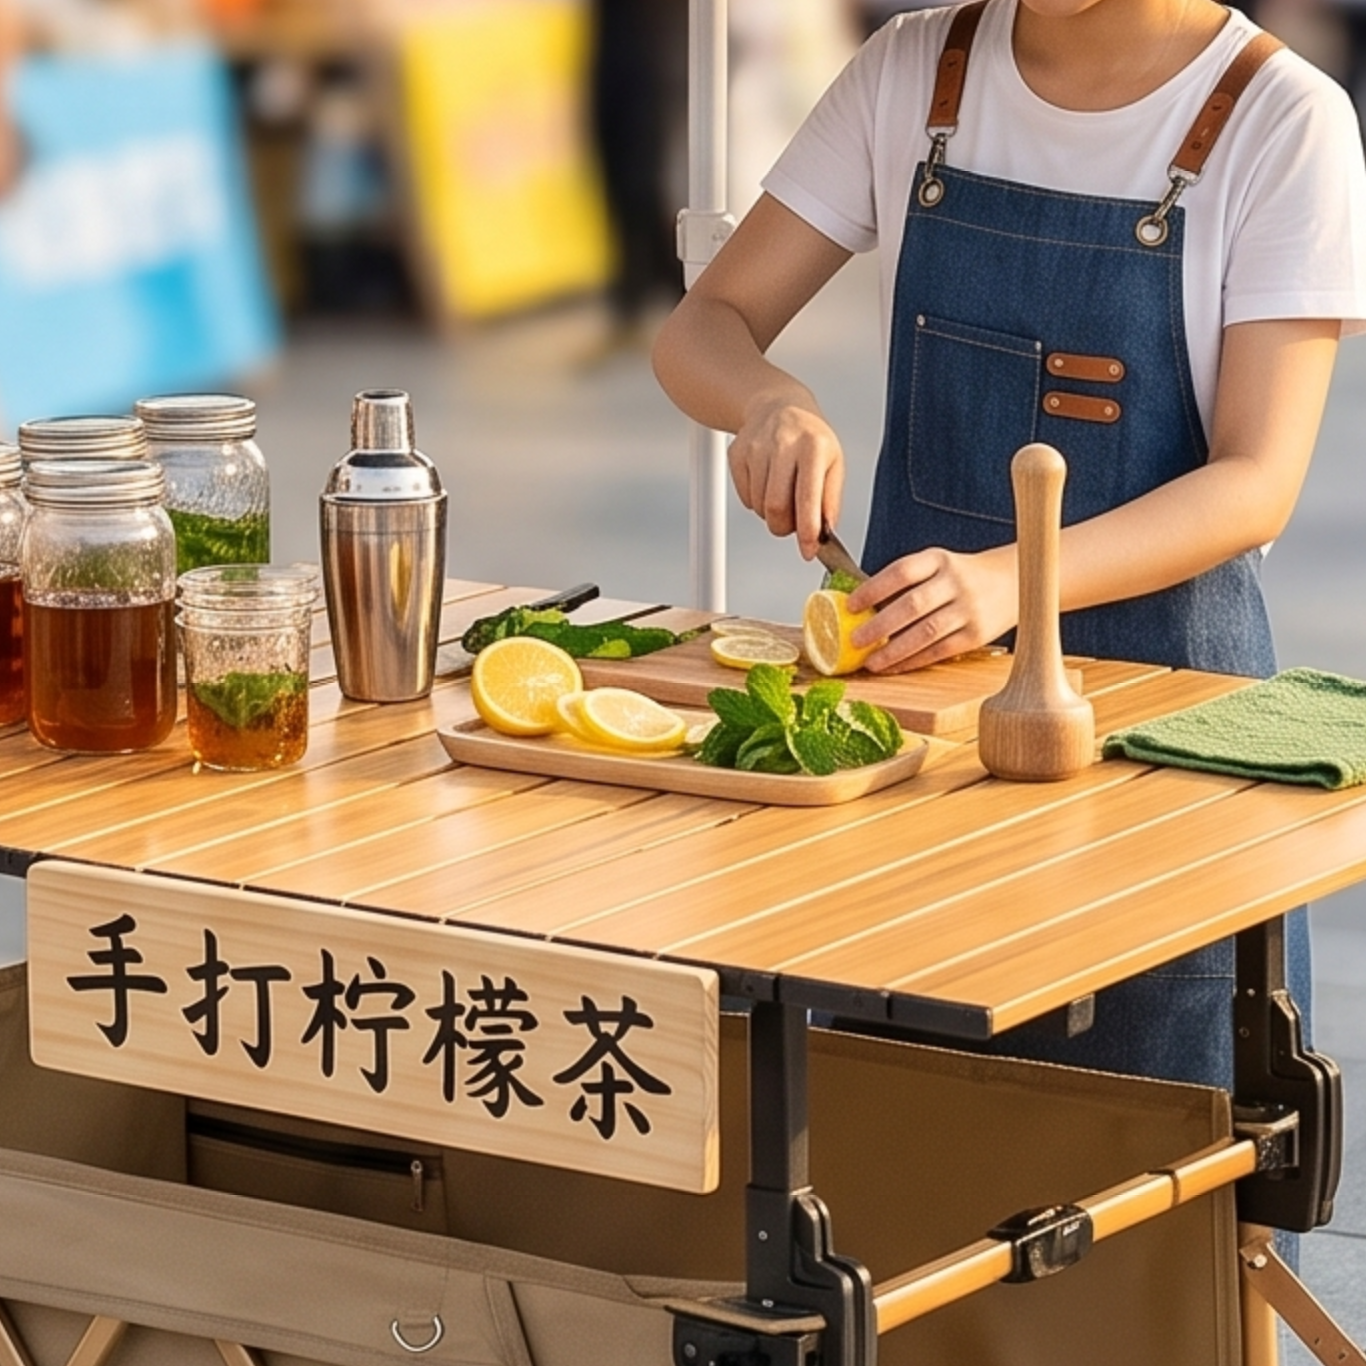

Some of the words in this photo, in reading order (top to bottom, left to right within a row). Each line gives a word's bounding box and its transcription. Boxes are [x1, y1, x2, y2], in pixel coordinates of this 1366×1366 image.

[65, 913, 673, 1141] 手打柠檬茶
